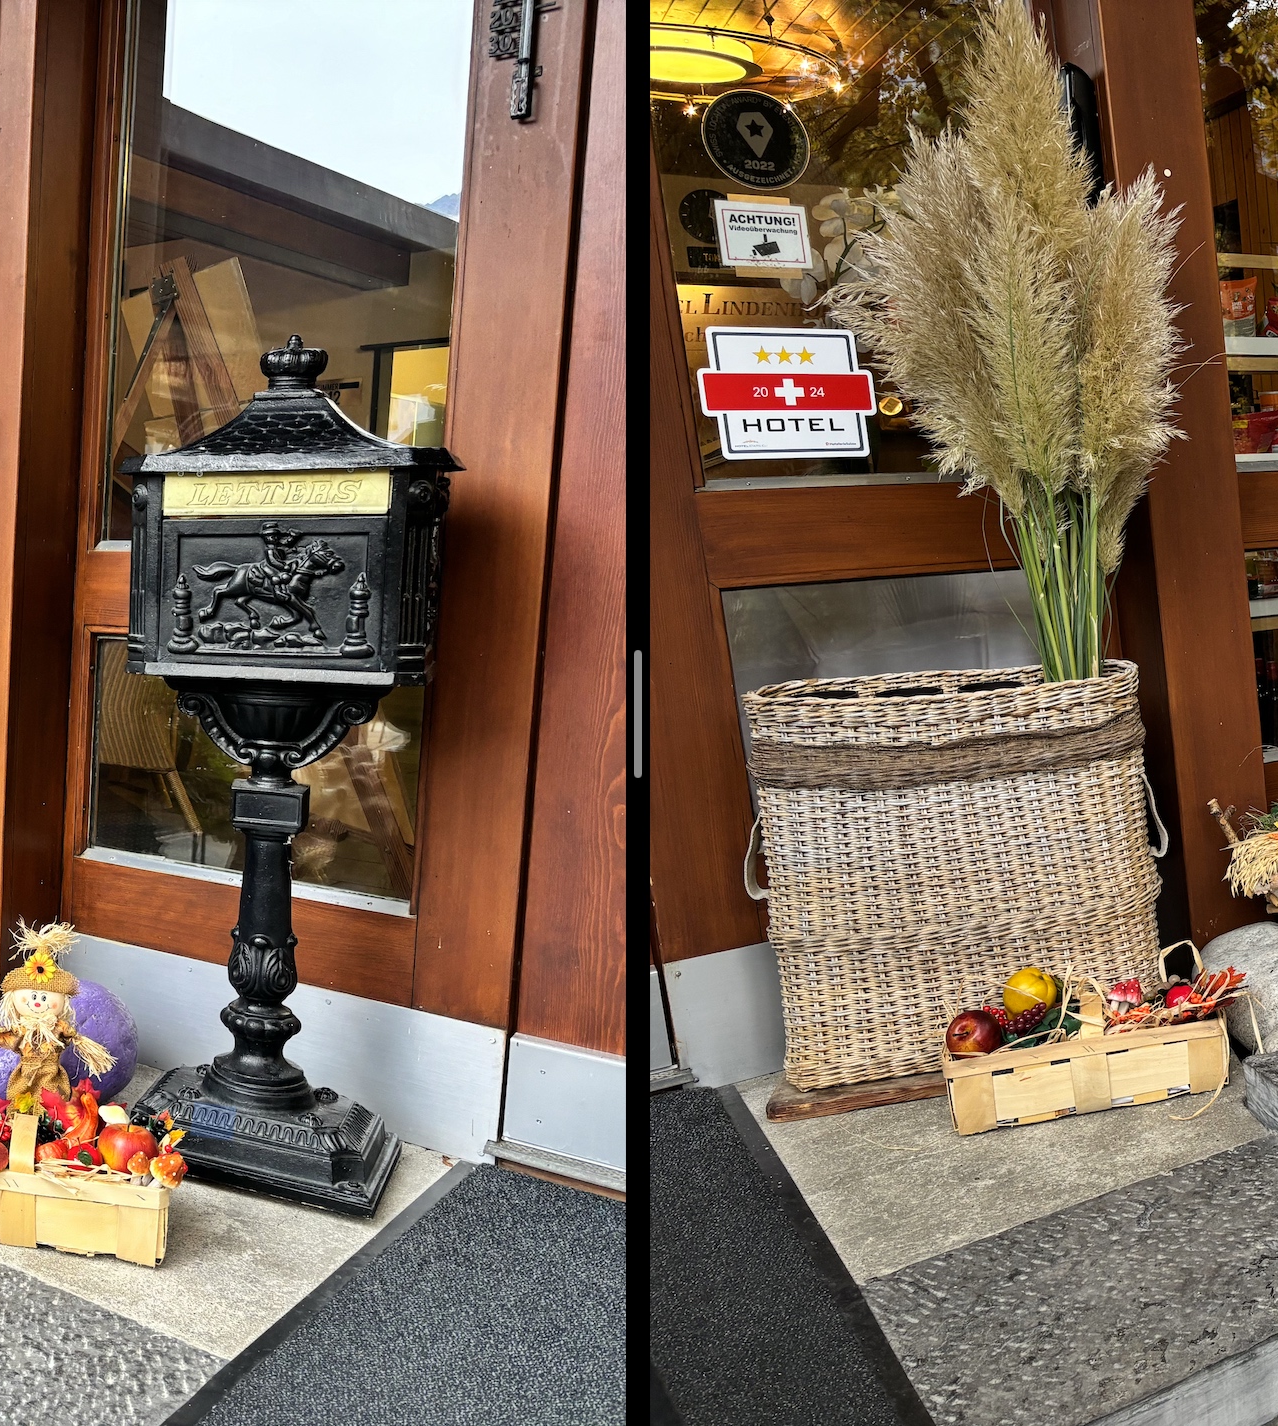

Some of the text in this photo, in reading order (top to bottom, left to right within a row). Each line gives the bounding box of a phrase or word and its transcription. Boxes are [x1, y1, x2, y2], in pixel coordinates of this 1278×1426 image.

[489, 6, 514, 29] 20
[488, 32, 513, 54] 30
[708, 133, 724, 158] SWISS
[743, 159, 776, 171] 2022
[726, 164, 793, 185] AUSGEZEICHNET
[729, 214, 796, 227] ACHTUNG!
[728, 224, 798, 236] Videoüberwachung
[752, 386, 825, 398] 20 24
[742, 417, 845, 433] HOTEL
[186, 478, 363, 507] LETTERS
